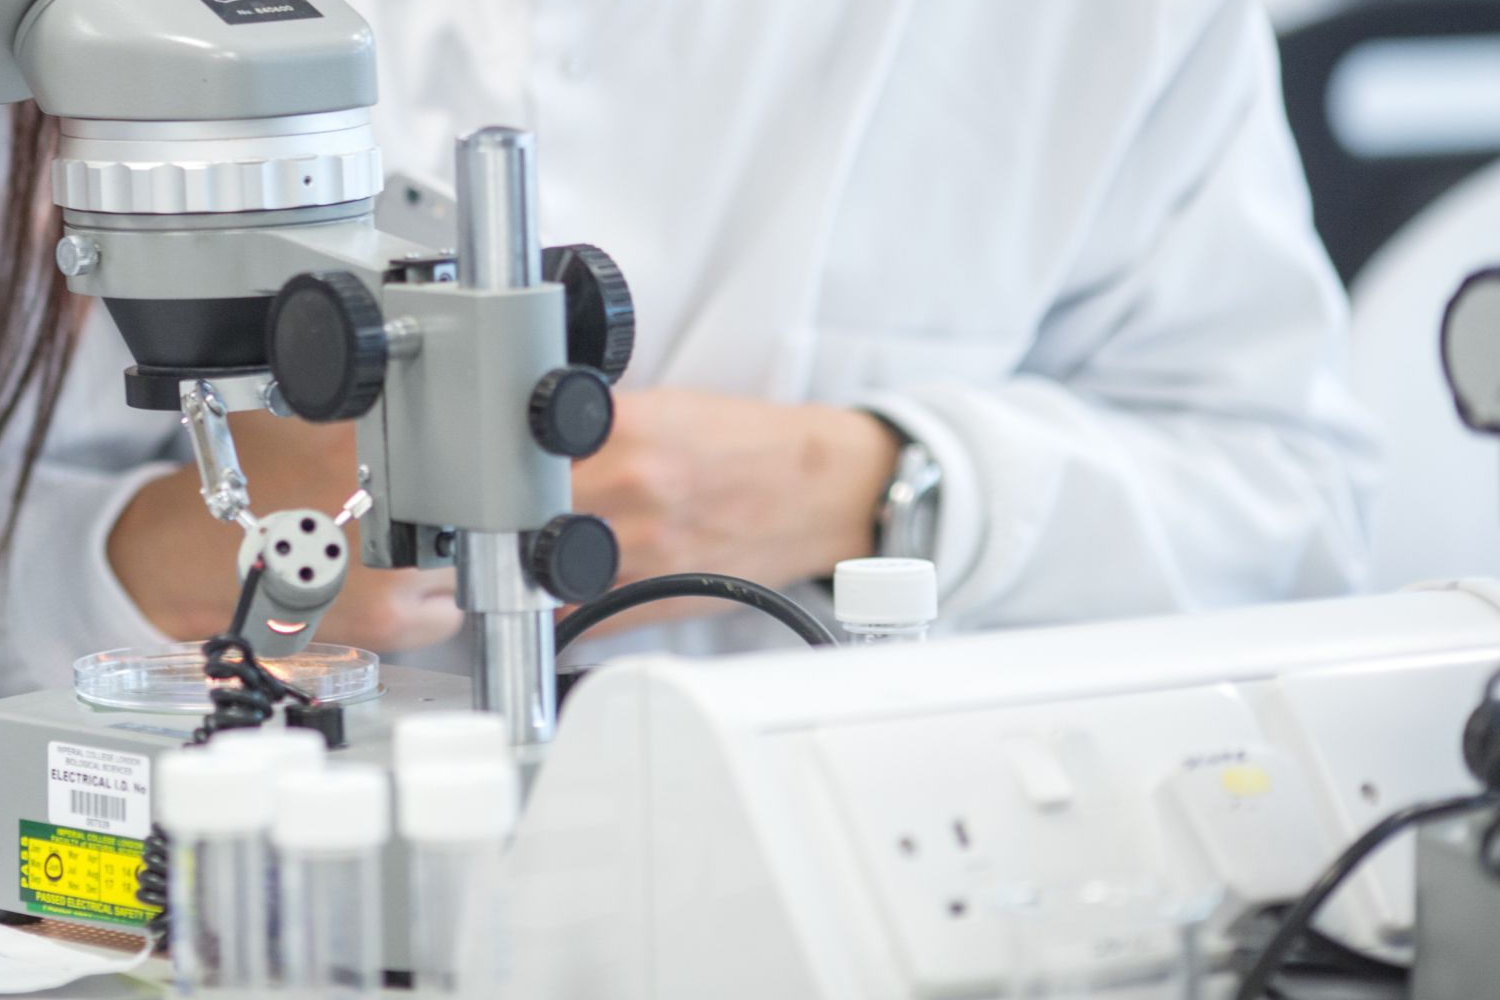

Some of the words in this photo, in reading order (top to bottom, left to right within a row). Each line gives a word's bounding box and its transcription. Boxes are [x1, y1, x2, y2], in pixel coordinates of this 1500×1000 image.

[51, 768, 111, 789] ELECTRICAL
[35, 890, 66, 906] PASSED
[67, 897, 113, 916] ELECTRICAL
[114, 906, 144, 921] SAFETY
